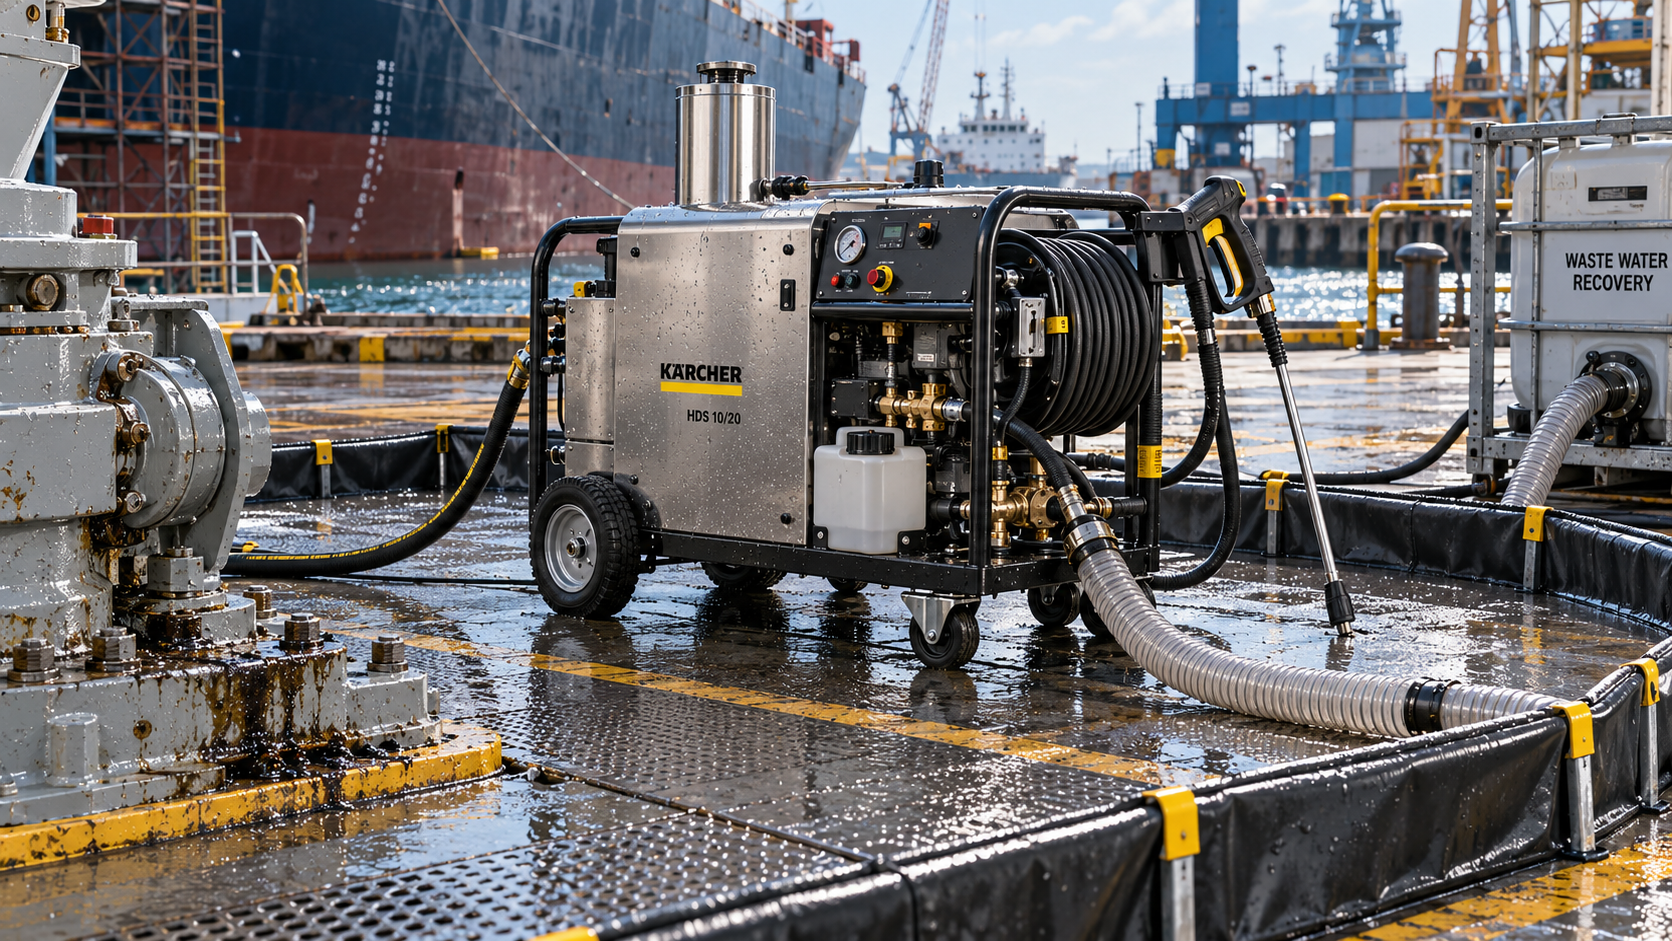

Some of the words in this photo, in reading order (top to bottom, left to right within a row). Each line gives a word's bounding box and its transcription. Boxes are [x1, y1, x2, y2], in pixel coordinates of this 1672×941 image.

[1565, 252, 1614, 269] WASTE
[1618, 252, 1668, 269] WATER
[1573, 274, 1654, 292] RECOVERY
[660, 362, 742, 383] KÄRCHER
[687, 409, 709, 422] HDS
[711, 411, 741, 424] 10/20
